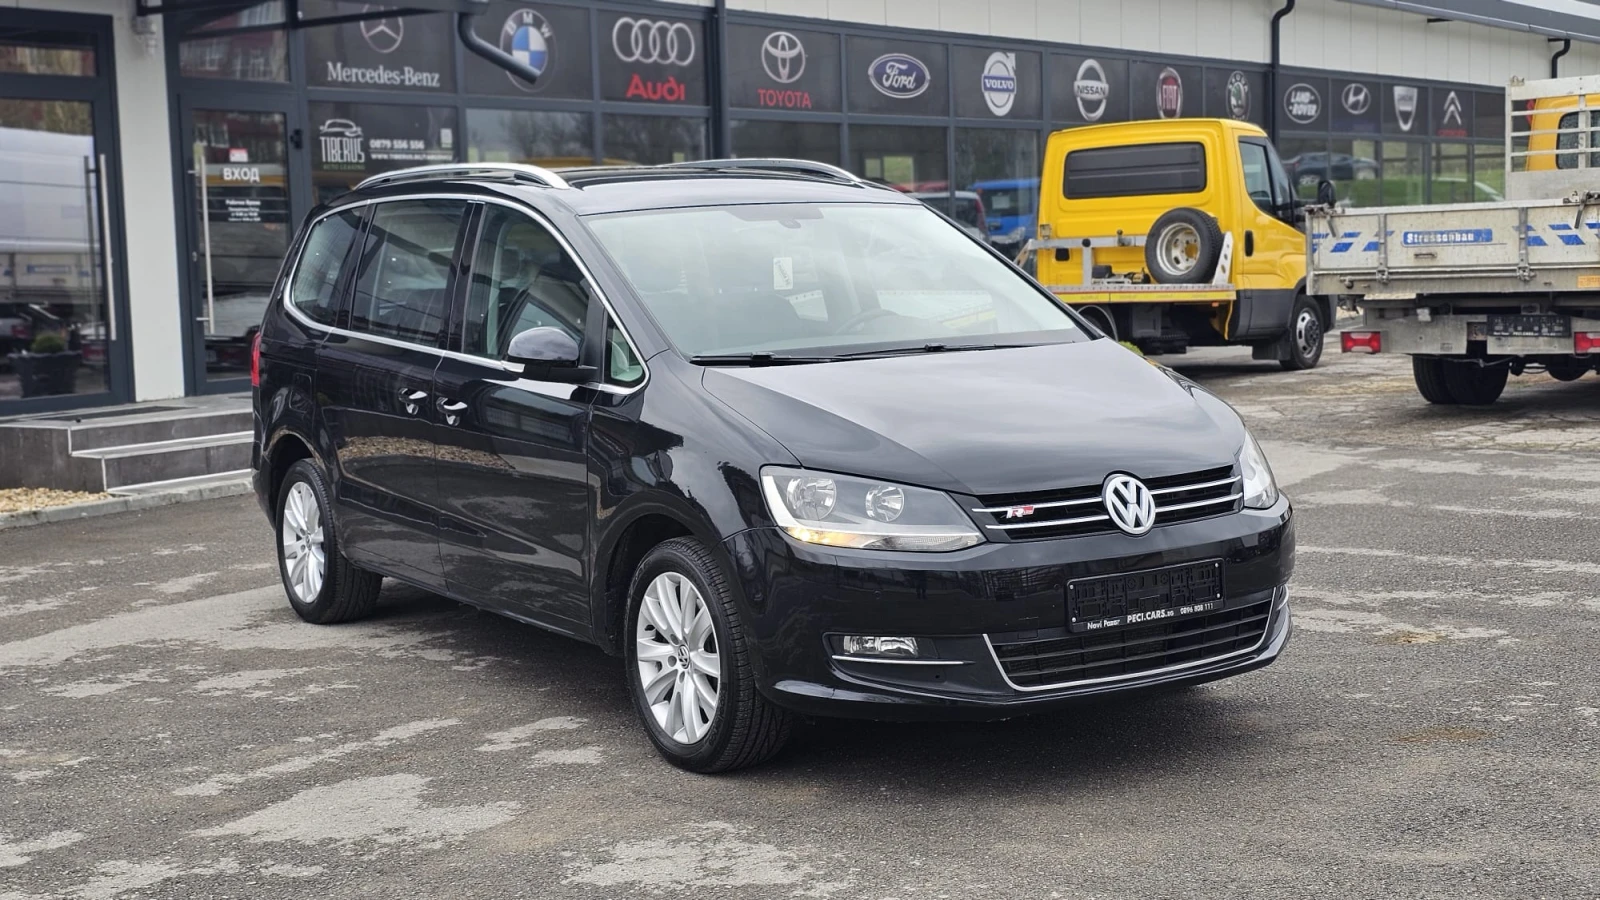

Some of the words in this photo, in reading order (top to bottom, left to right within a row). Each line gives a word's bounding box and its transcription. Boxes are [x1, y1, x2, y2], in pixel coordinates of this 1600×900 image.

[327, 61, 440, 87] Mercedes-Benz
[626, 73, 686, 100] Audi
[882, 61, 917, 89] Ford
[985, 79, 1014, 89] VOLVO
[757, 88, 812, 109] TOYOTA
[1077, 84, 1106, 95] NISSAN
[1162, 85, 1178, 110] FIAT
[319, 136, 366, 163] TIBERUS
[223, 167, 260, 183] ВХОД
